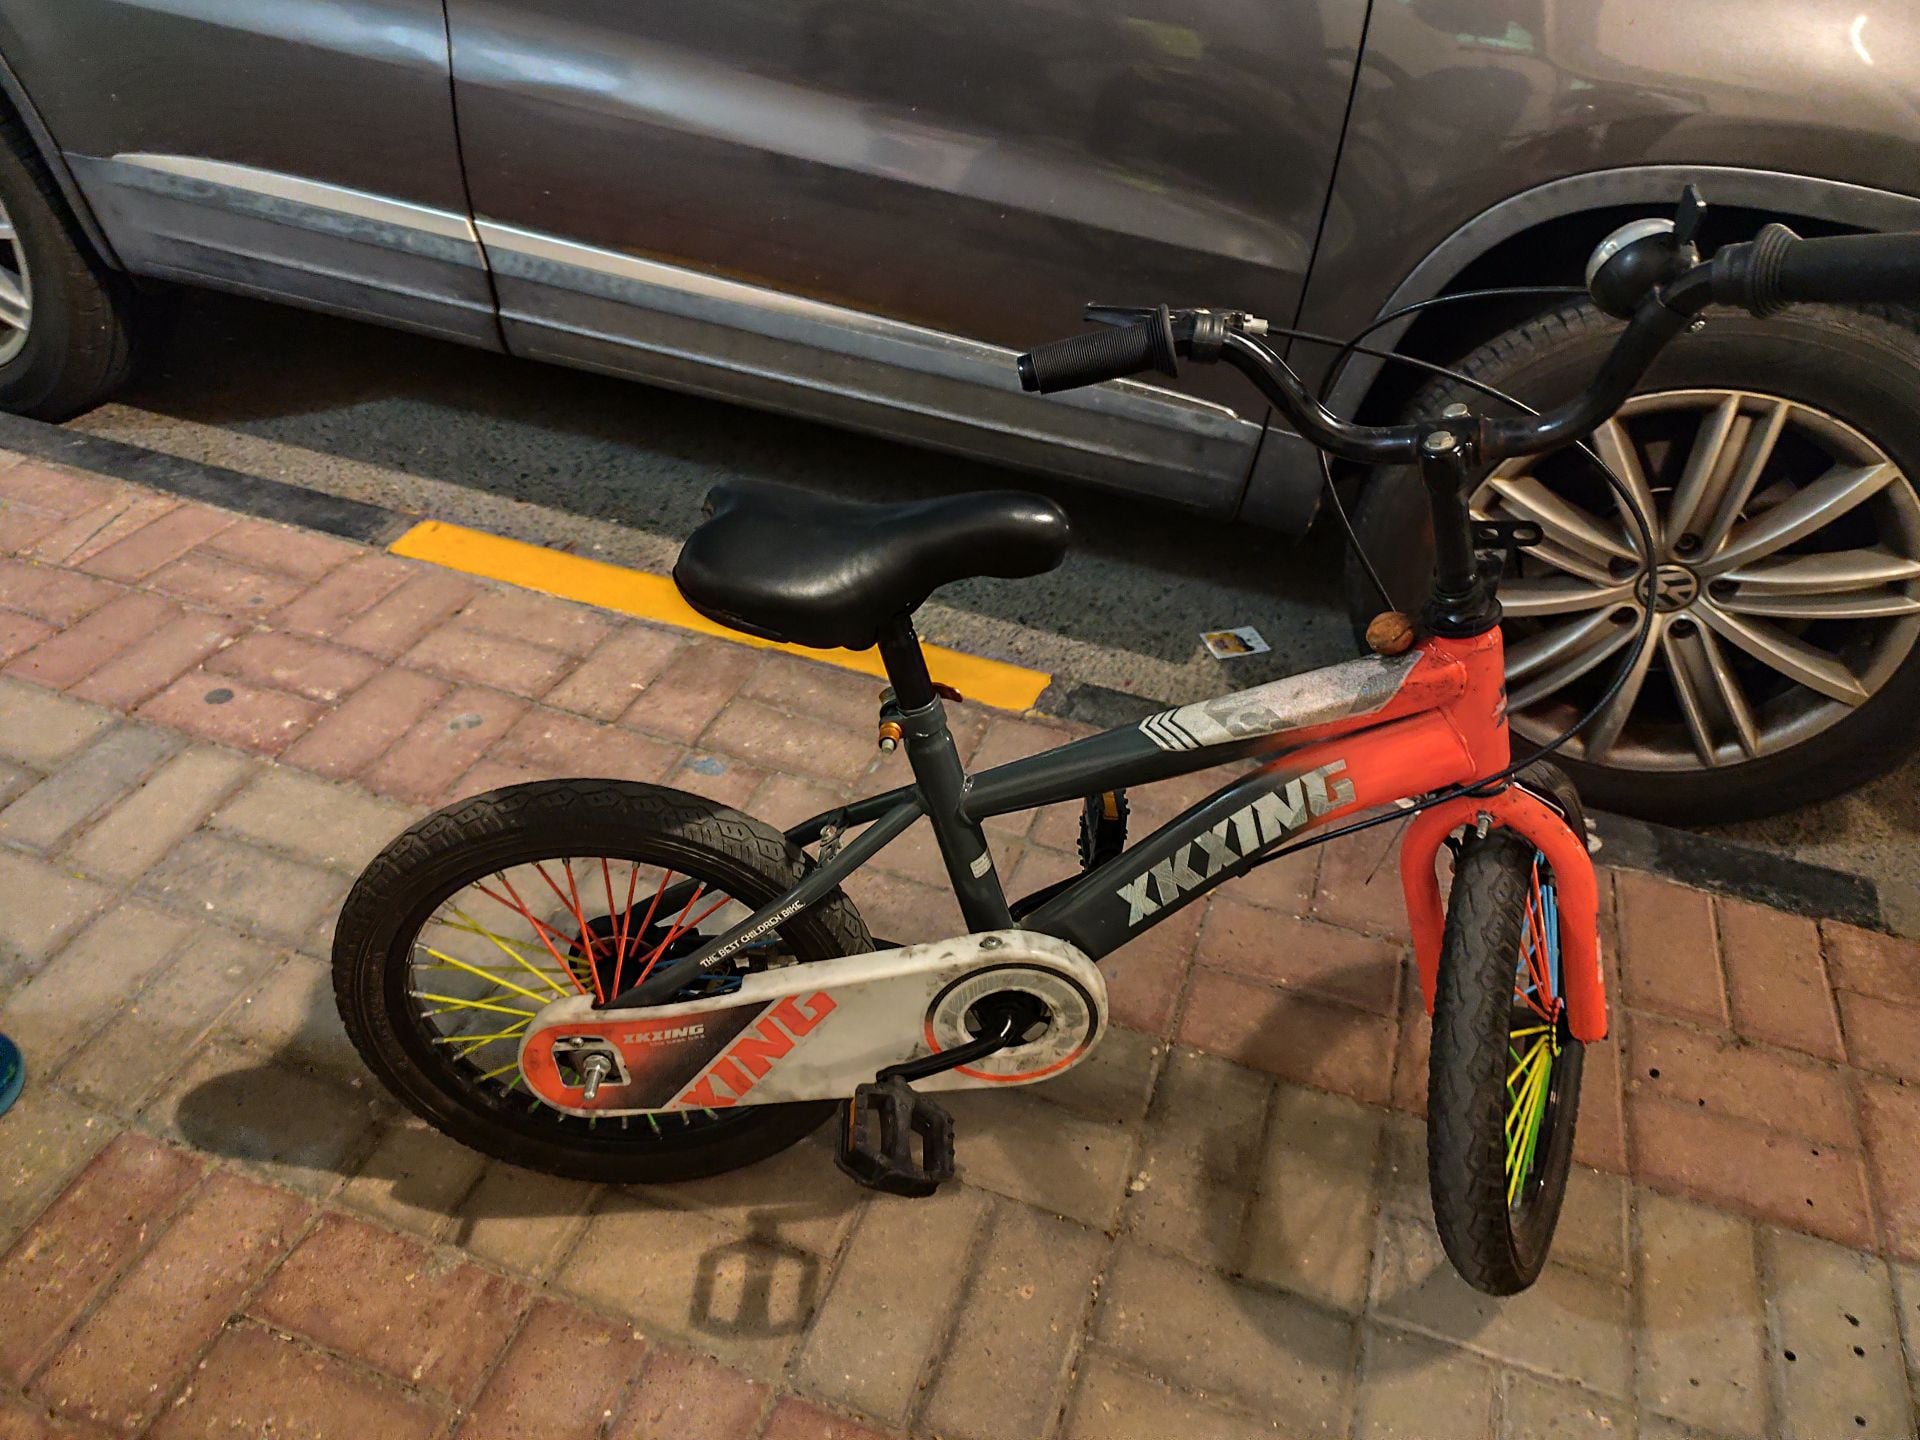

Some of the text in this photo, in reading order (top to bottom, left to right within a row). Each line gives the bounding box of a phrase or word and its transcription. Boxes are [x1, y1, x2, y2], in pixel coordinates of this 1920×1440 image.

[1116, 758, 1356, 928] XKXING
[699, 953, 720, 968] THE
[718, 939, 741, 957] BEST
[740, 914, 782, 943] CHILDREN
[623, 1023, 705, 1044] XKXING
